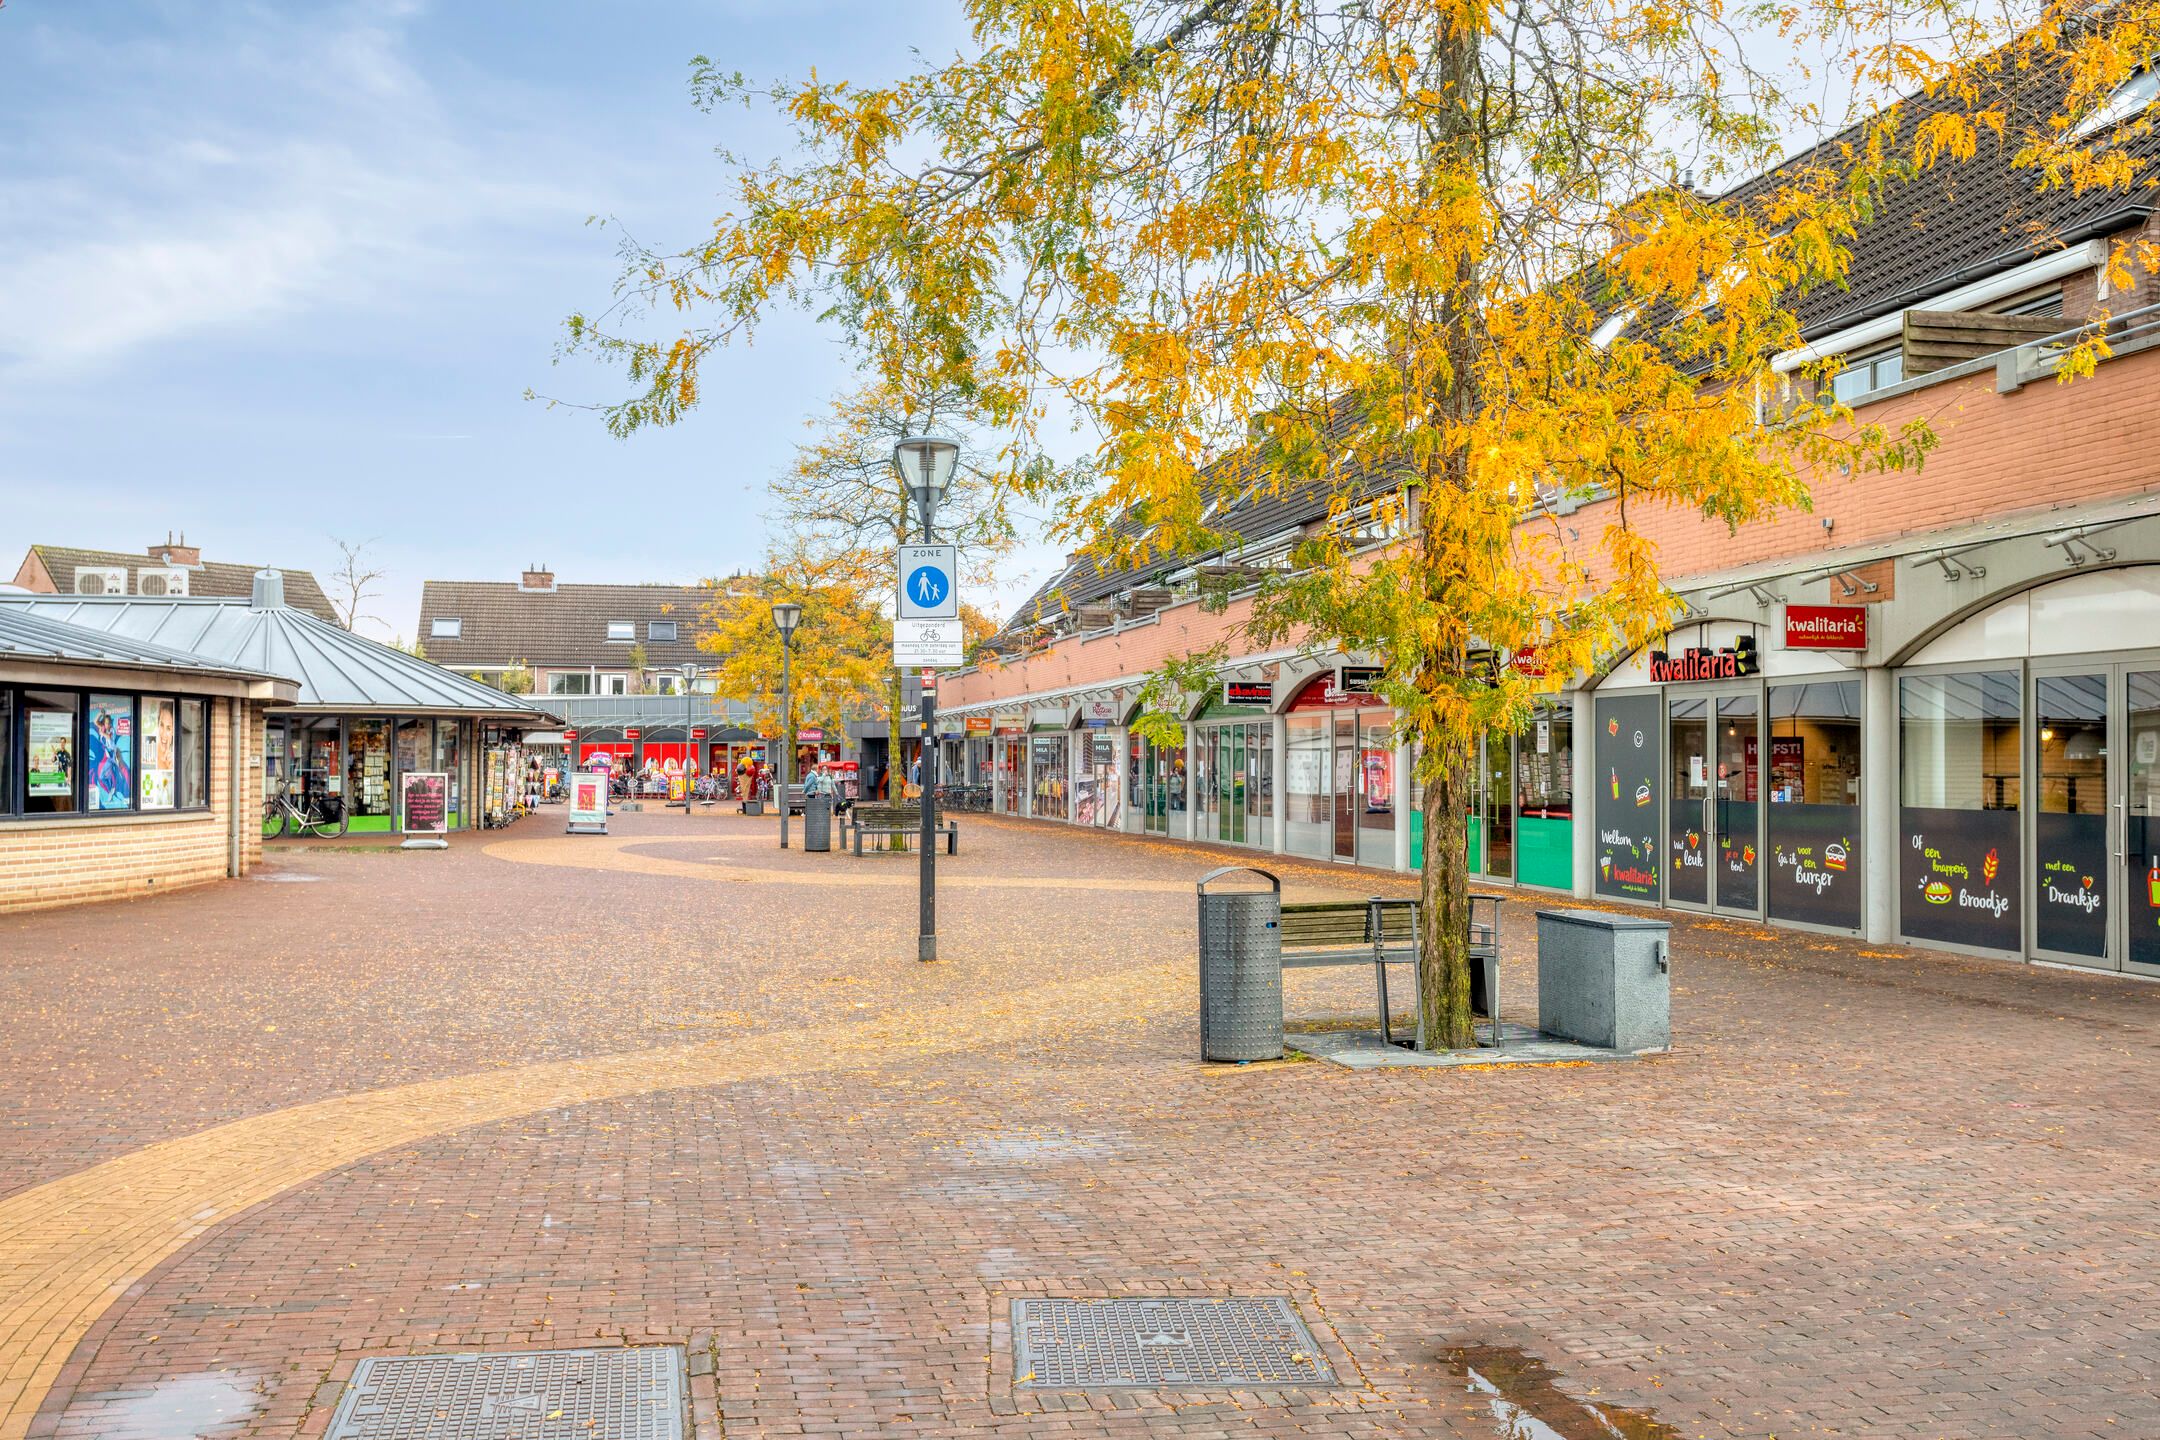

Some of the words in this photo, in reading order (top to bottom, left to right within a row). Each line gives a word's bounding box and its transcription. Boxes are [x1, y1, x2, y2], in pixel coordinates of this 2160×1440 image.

[1787, 615, 1856, 632] kwalitaria
[1650, 648, 1736, 682] kwalitaria
[1747, 743, 1801, 755] HFST!
[1601, 829, 1632, 847] Welkom
[1673, 840, 1684, 850] Wat
[1912, 834, 1923, 849] Of
[1683, 849, 1704, 868] leuk
[1777, 852, 1789, 867] Ga
[1789, 850, 1798, 866] ik
[1797, 847, 1813, 856] voor
[1924, 848, 1941, 859] een
[1803, 858, 1817, 869] een
[1932, 859, 1968, 880] knapperig
[2045, 861, 2060, 872] met
[2061, 863, 2076, 873] een
[1613, 863, 1653, 886] kwalitaria
[1959, 888, 2009, 919] Broodje
[2049, 886, 2101, 914] Drankje
